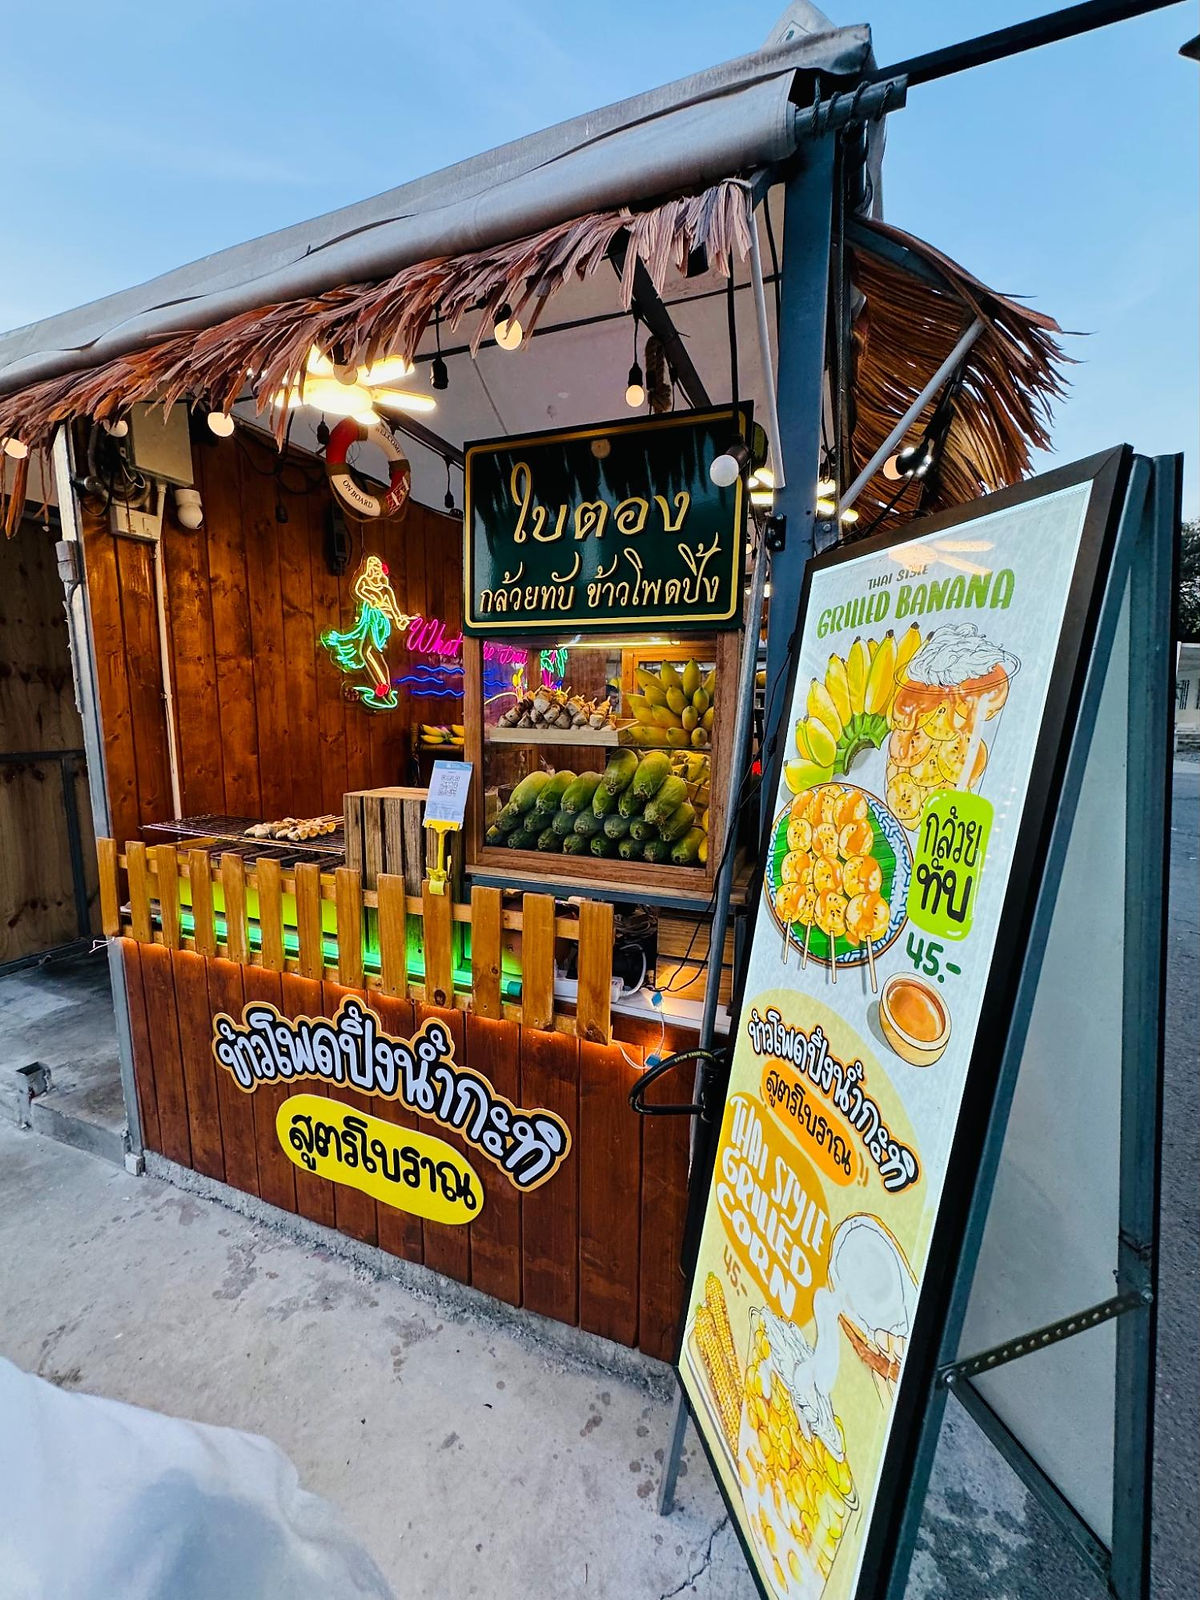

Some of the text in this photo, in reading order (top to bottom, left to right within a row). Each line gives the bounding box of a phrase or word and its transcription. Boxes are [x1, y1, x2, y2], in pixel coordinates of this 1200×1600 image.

[342, 479, 374, 509] ON BOARD
[510, 461, 691, 543] ใบตอง
[479, 532, 722, 612] กล้วยทับ ข้าวโพดปิ้ง
[816, 568, 1015, 639] GRILLED BANANA
[867, 573, 893, 590] THAI
[922, 805, 983, 868] กล้วย
[916, 857, 973, 923] ทับ
[217, 1002, 565, 1186] ข้าวโพดปิ้งน้ำกะทิ
[748, 1008, 917, 1191] ข้าวโพดปิ้งน้ำกะทิ
[766, 1071, 852, 1176] สูตรโบราณ
[289, 1114, 478, 1210] สูตรโบราณ
[730, 1095, 829, 1256] THAI STYLE
[716, 1182, 797, 1318] CORN
[722, 1146, 813, 1288] GRILLED
